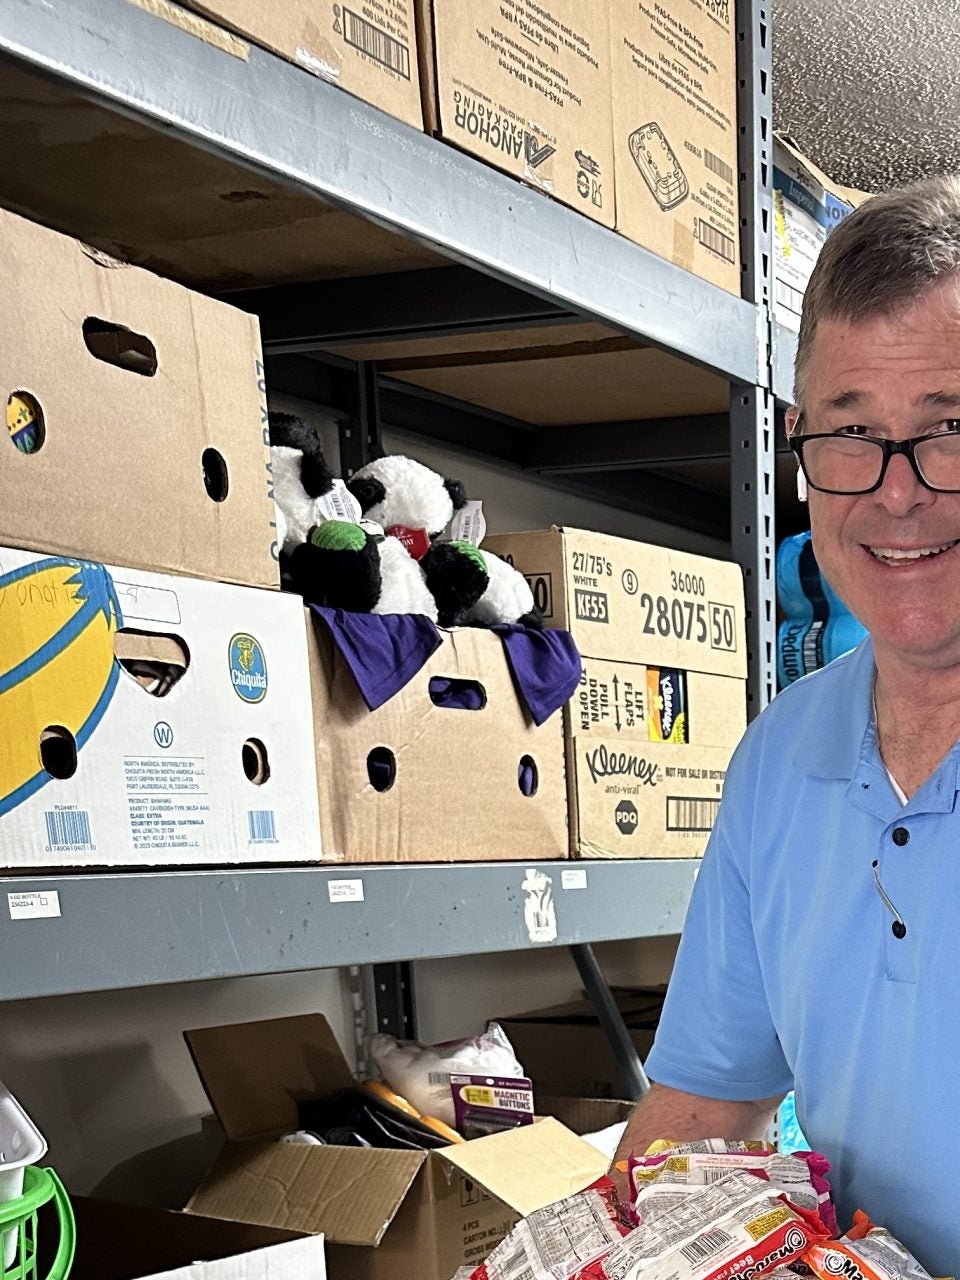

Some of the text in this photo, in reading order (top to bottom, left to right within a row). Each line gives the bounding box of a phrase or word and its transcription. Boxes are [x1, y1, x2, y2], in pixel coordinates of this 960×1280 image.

[528, 77, 533, 88] &
[453, 90, 523, 138] PACKAGING
[454, 104, 523, 159] ANCHOR
[572, 552, 612, 577] 27/75's
[671, 570, 705, 597] 36000
[573, 575, 598, 587] WHITE
[576, 593, 606, 620] KF55
[640, 593, 733, 648] 28075 50
[231, 669, 267, 691] Chiquita
[580, 668, 590, 731] TO OPEN
[589, 678, 600, 722] DOWN
[599, 683, 610, 720] PULL
[624, 681, 635, 727] FLAPS
[635, 691, 645, 721] LIFT
[660, 676, 674, 732] Kleenex
[586, 744, 658, 787] Kleenex
[665, 767, 709, 779] NOT FOR SALE OR
[605, 783, 640, 795] anti-viral
[616, 811, 637, 825] PDQ
[494, 1090, 530, 1101] MAGNETIC
[499, 1099, 531, 1111] BUTTONS
[464, 1232, 486, 1245] CARTON
[464, 1244, 484, 1258] GROSS
[730, 1255, 755, 1273] Beef
